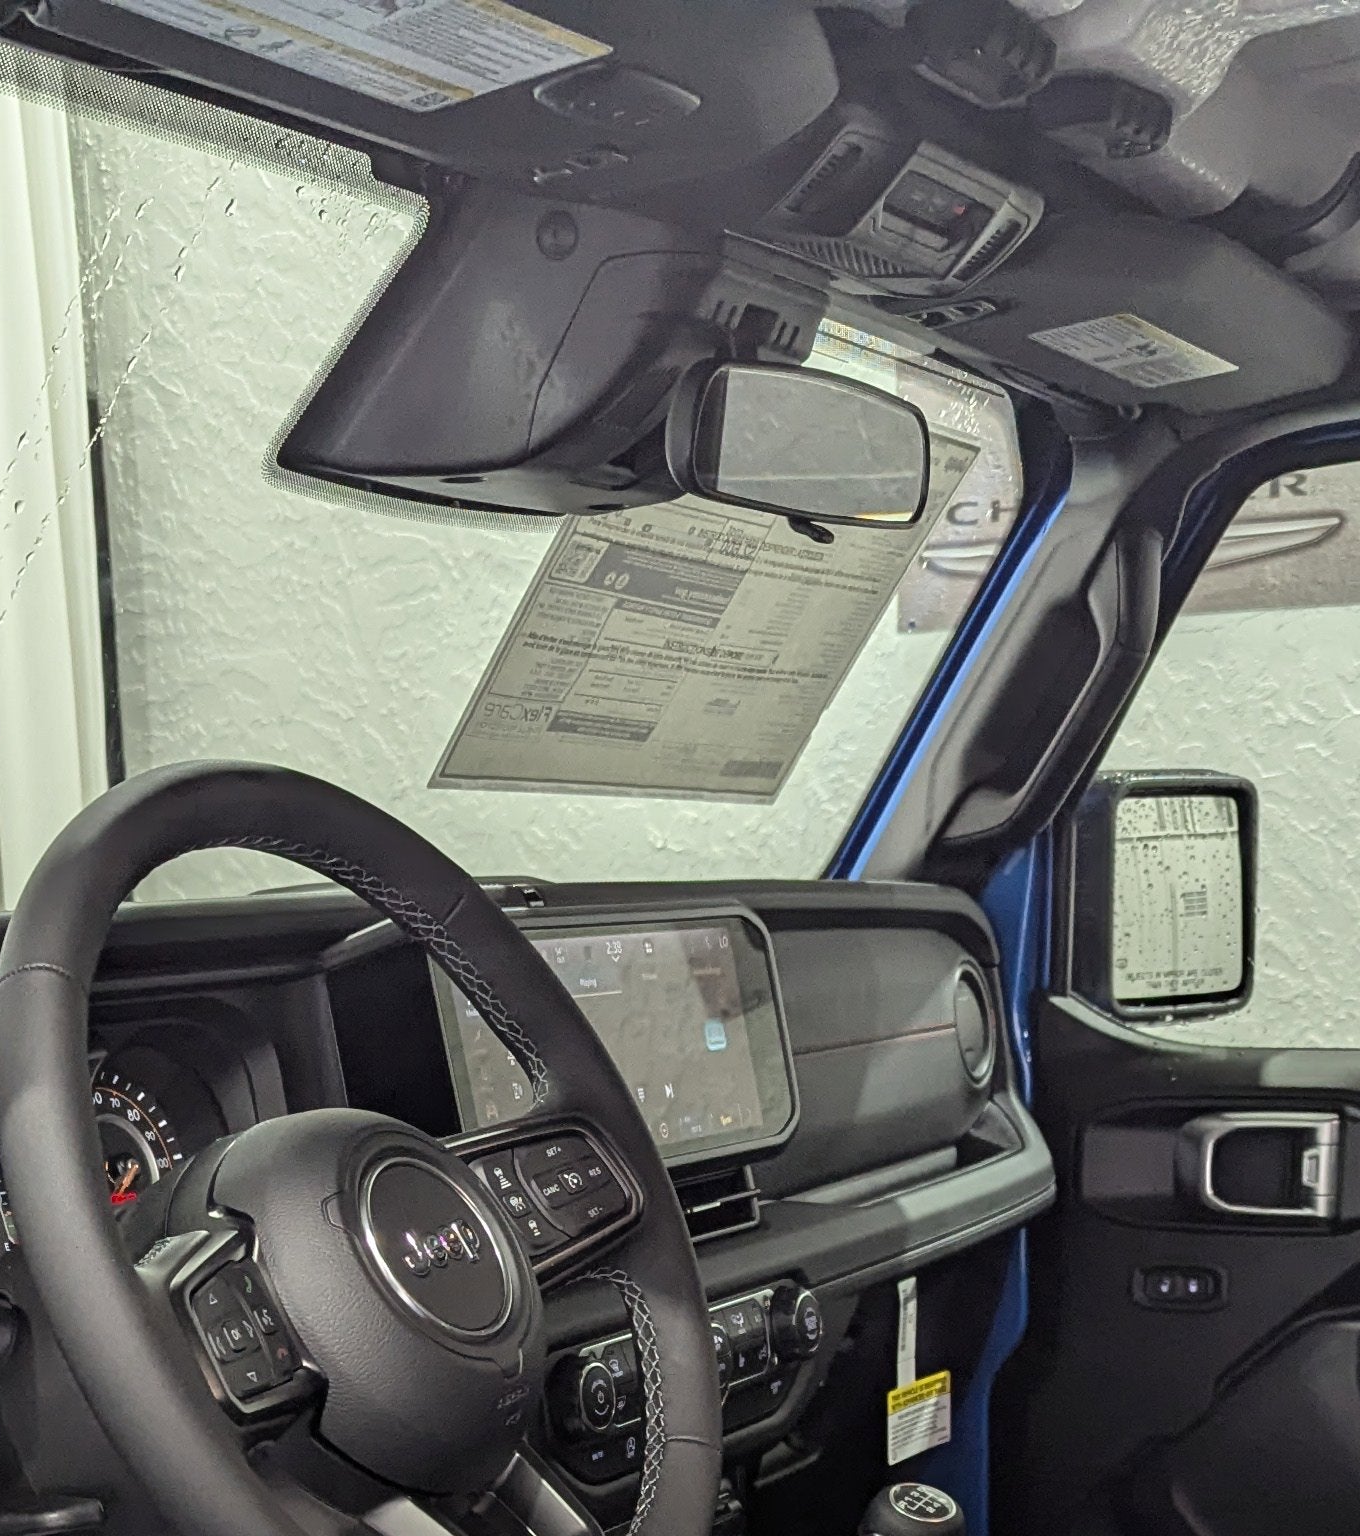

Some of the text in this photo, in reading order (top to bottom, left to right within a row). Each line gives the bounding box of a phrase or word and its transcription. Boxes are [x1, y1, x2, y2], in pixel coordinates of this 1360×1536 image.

[109, 1097, 121, 1109] 70
[127, 1108, 141, 1122] 80
[144, 1130, 156, 1142] 90
[158, 1157, 169, 1169] 00
[543, 1183, 560, 1197] CANC
[4, 1242, 11, 1252] E
[403, 1219, 481, 1276] Jeep
